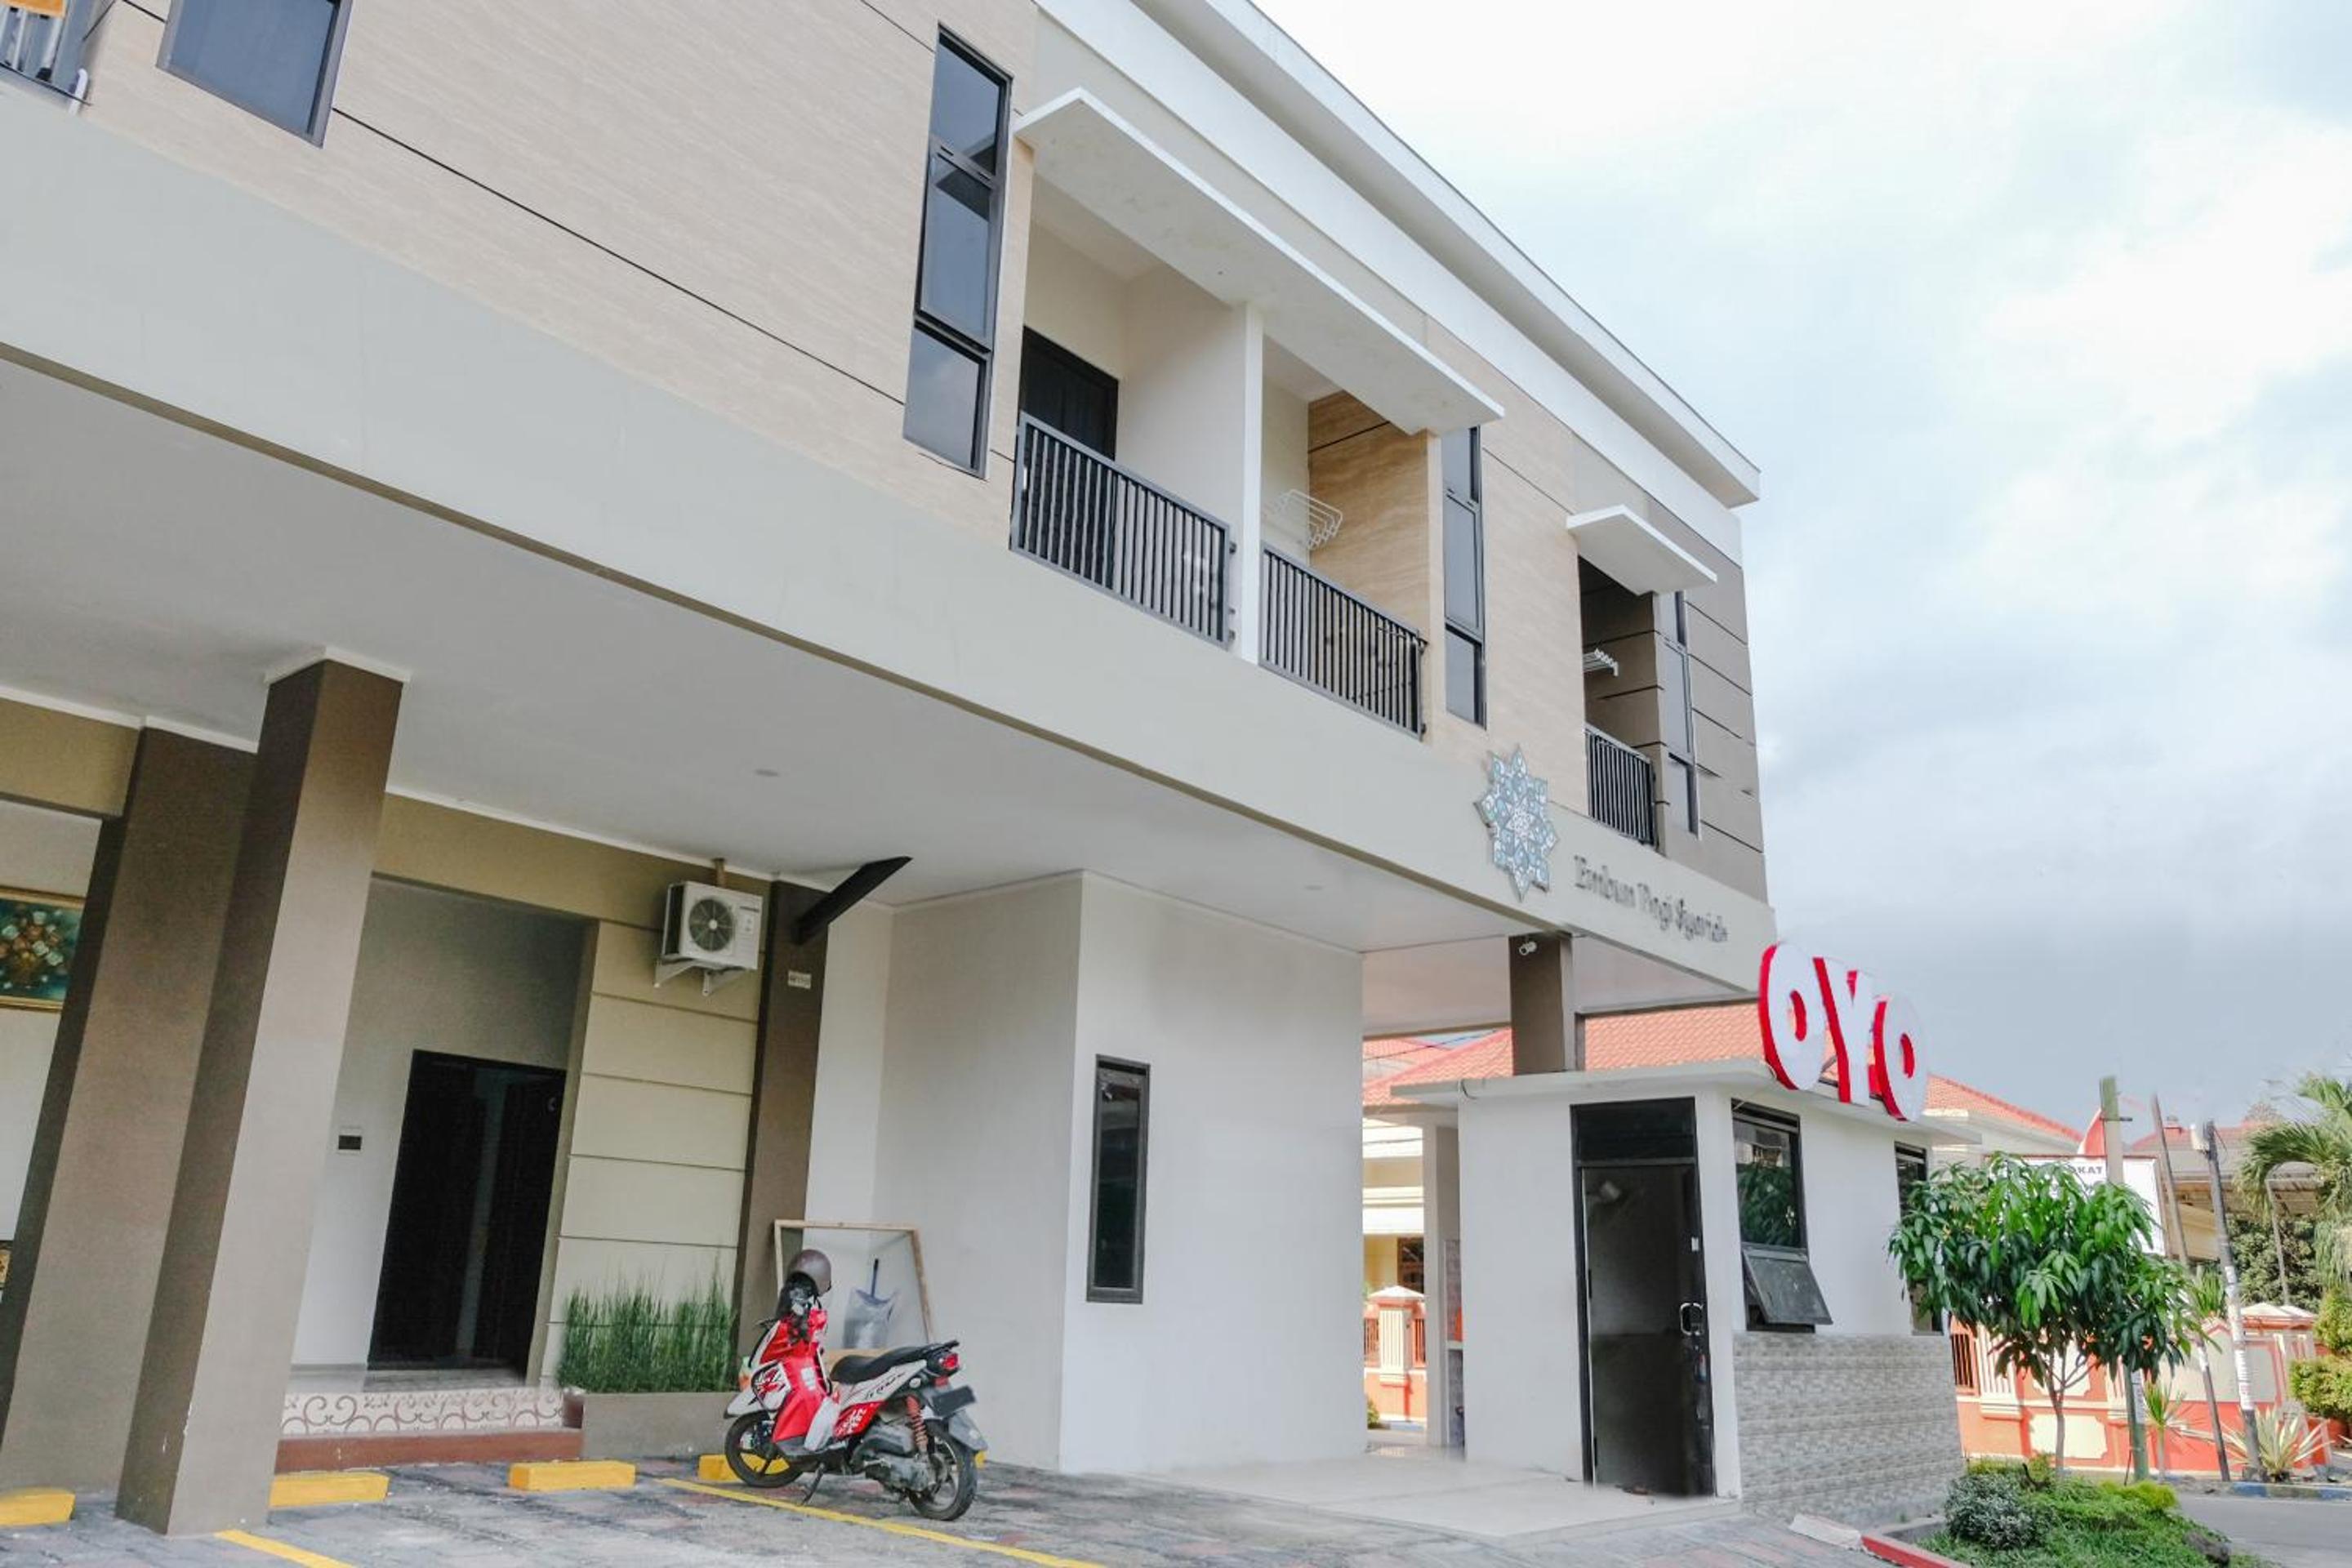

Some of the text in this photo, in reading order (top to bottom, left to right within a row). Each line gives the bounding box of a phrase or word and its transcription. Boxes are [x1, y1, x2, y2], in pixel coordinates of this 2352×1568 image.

[1574, 855, 1636, 908] Embun
[1675, 898, 1728, 942] Syariah
[1757, 942, 1930, 1122] OYO
